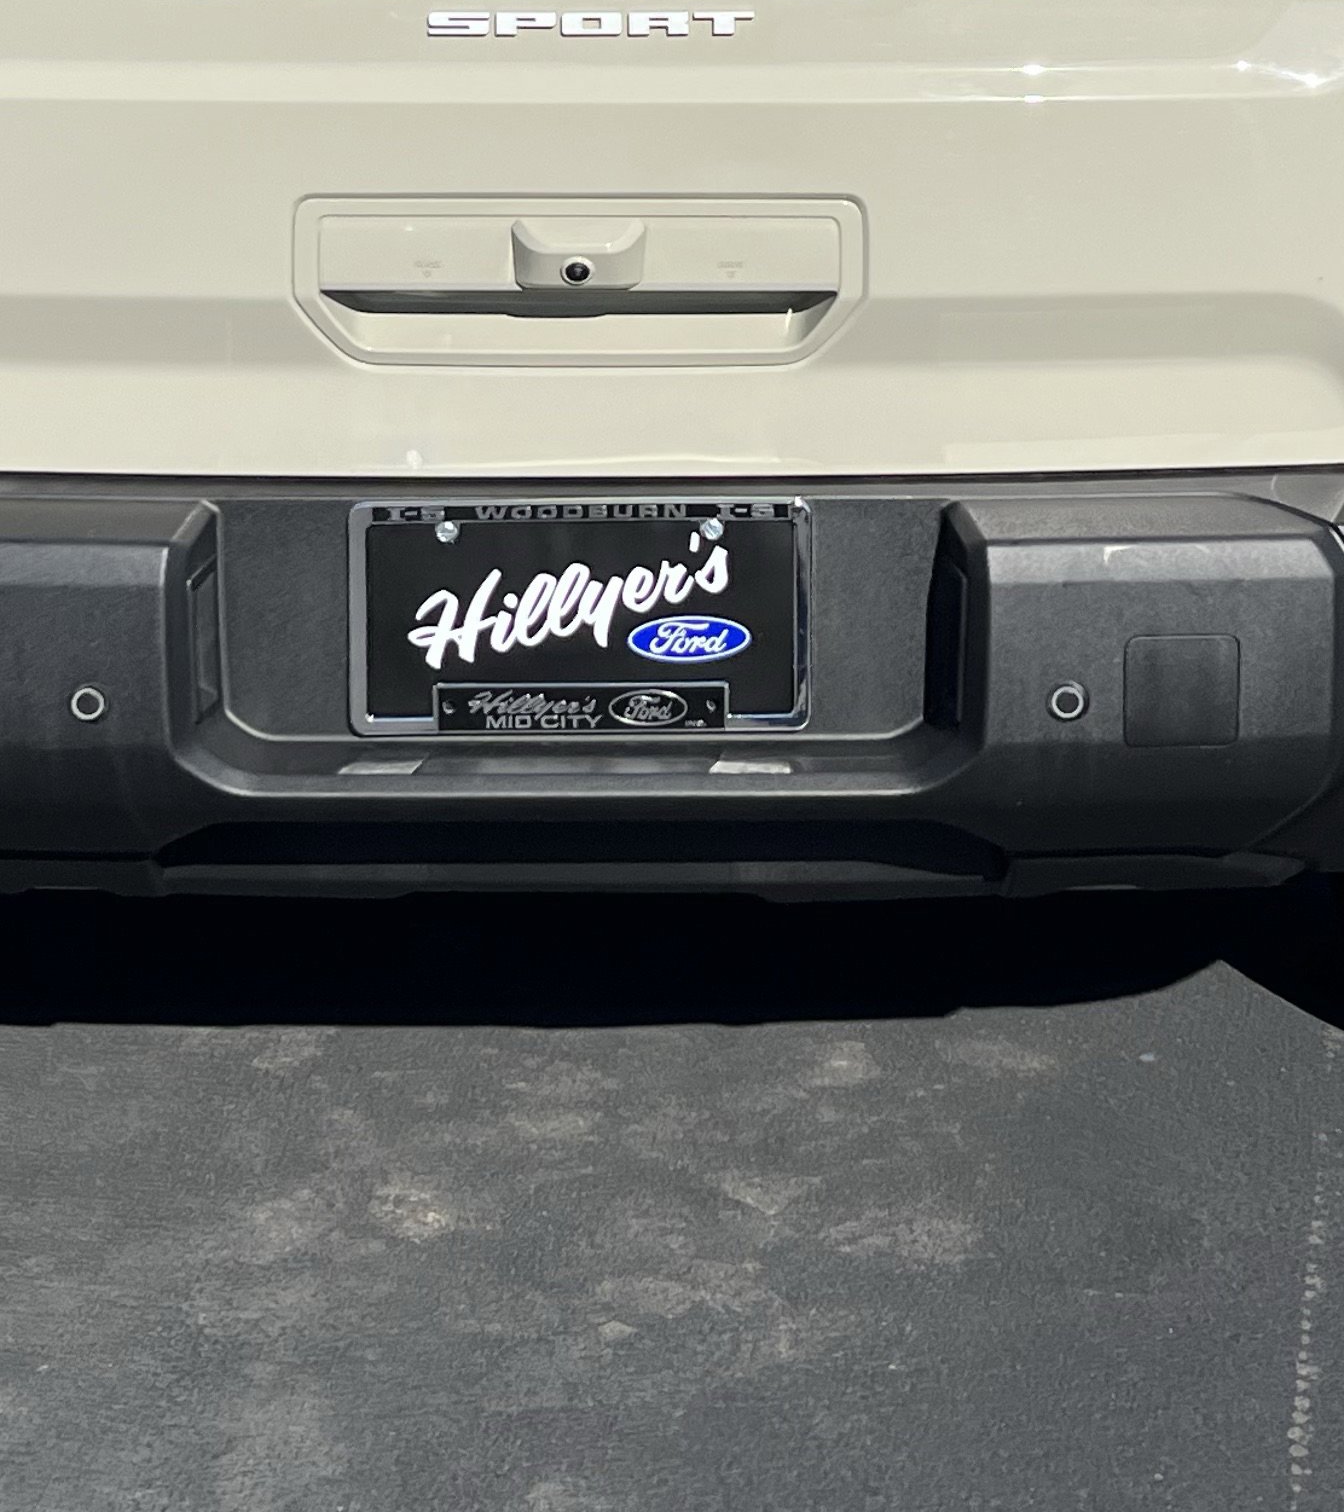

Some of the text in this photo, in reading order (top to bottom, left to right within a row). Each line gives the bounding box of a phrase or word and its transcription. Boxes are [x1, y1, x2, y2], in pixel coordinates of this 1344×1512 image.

[426, 10, 756, 38] SPORT
[387, 503, 775, 522] I-5 WOODBURN I-5
[407, 531, 730, 670] Hillyer's
[649, 621, 728, 656] Ford
[468, 689, 597, 720] Hillyer's
[623, 694, 673, 721] Ford
[485, 714, 603, 729] MID CITY
